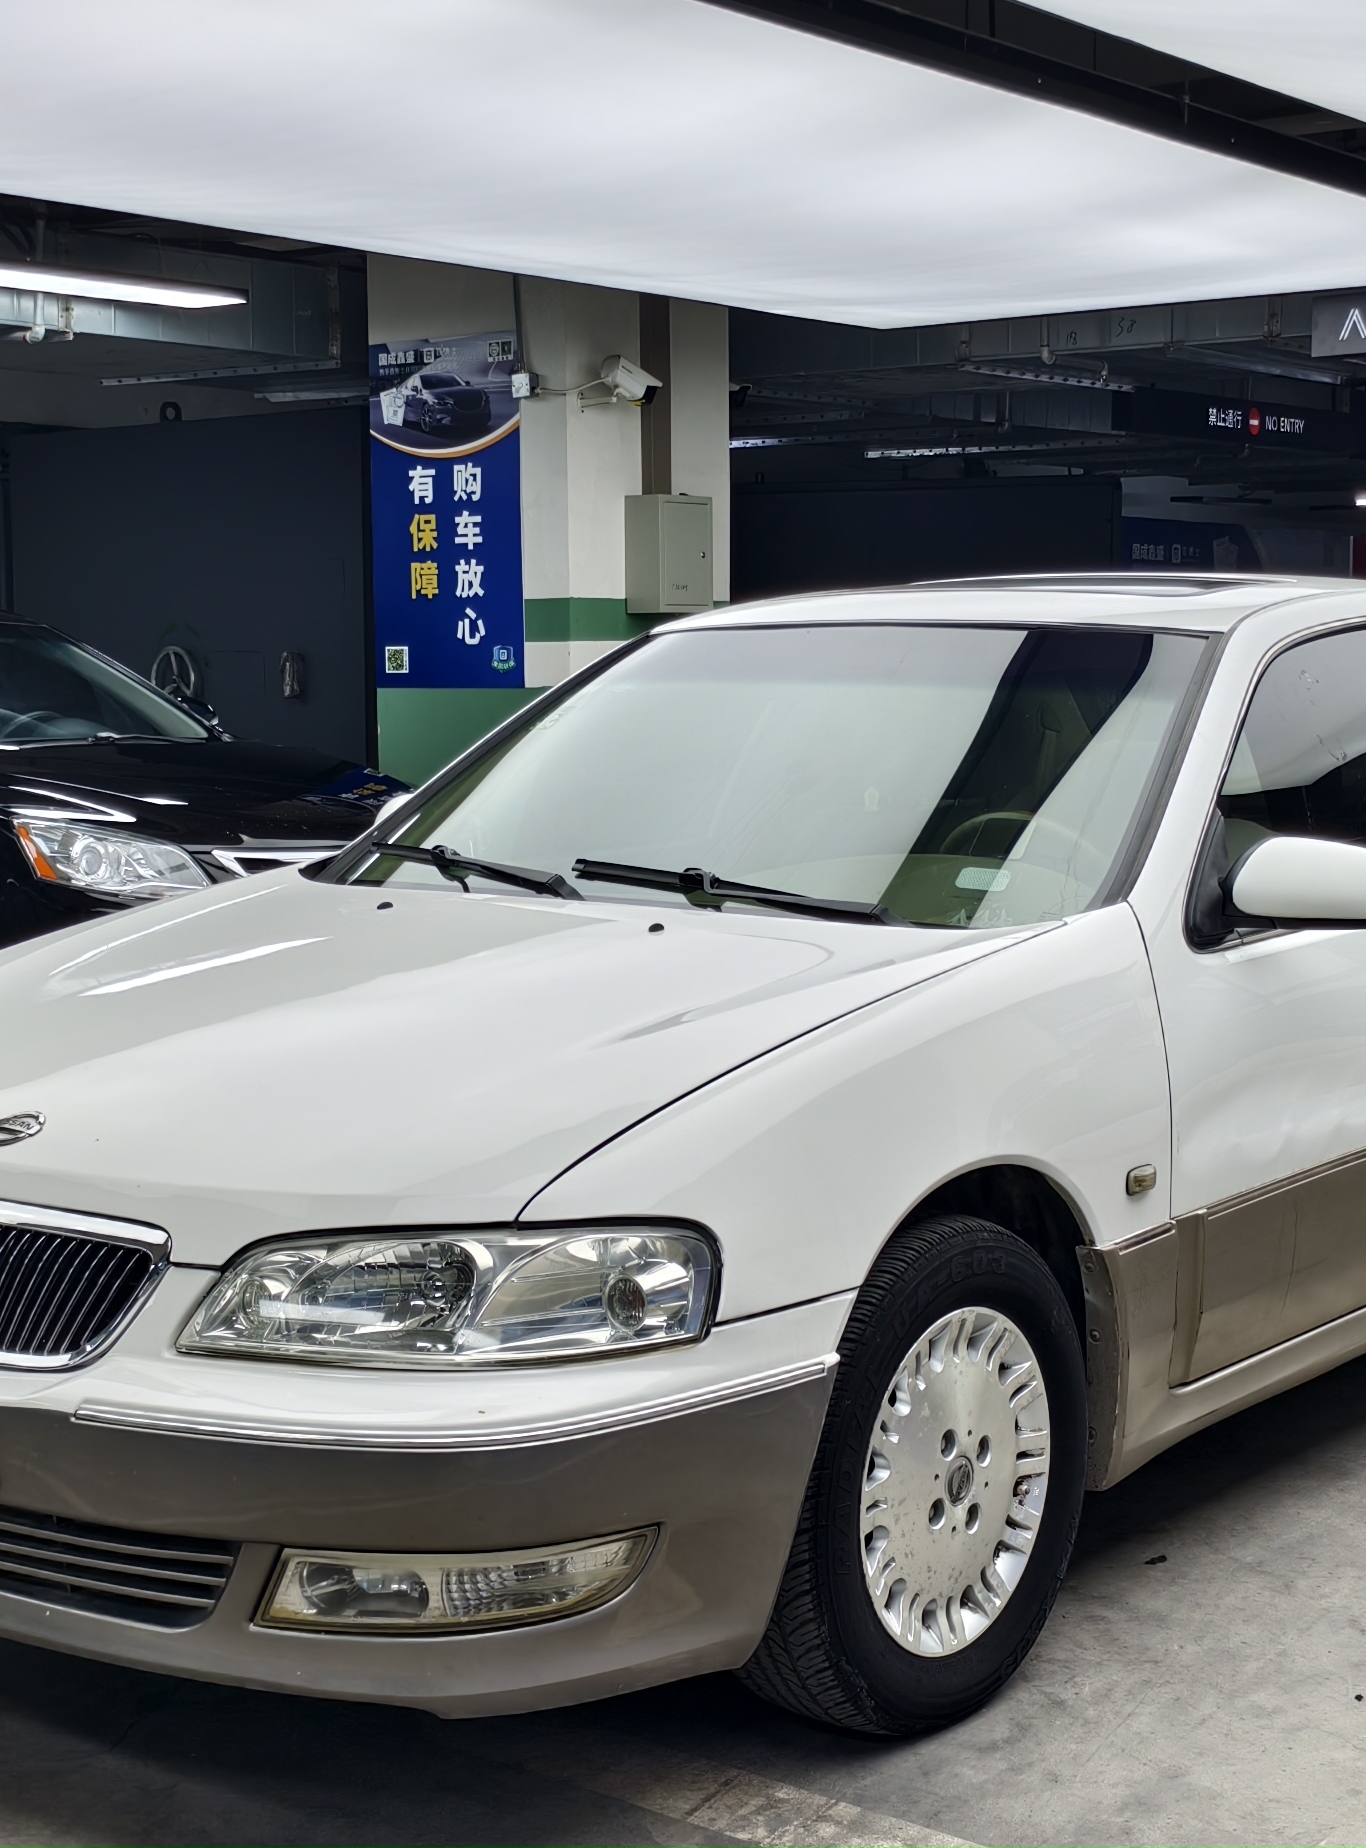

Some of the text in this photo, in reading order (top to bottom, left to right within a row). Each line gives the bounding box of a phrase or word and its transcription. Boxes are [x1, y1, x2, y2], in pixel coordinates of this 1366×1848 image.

[1208, 407, 1305, 434] 禁止通行 NO ENTRY
[408, 465, 439, 600] 有保障
[453, 462, 486, 646] 购车放心
